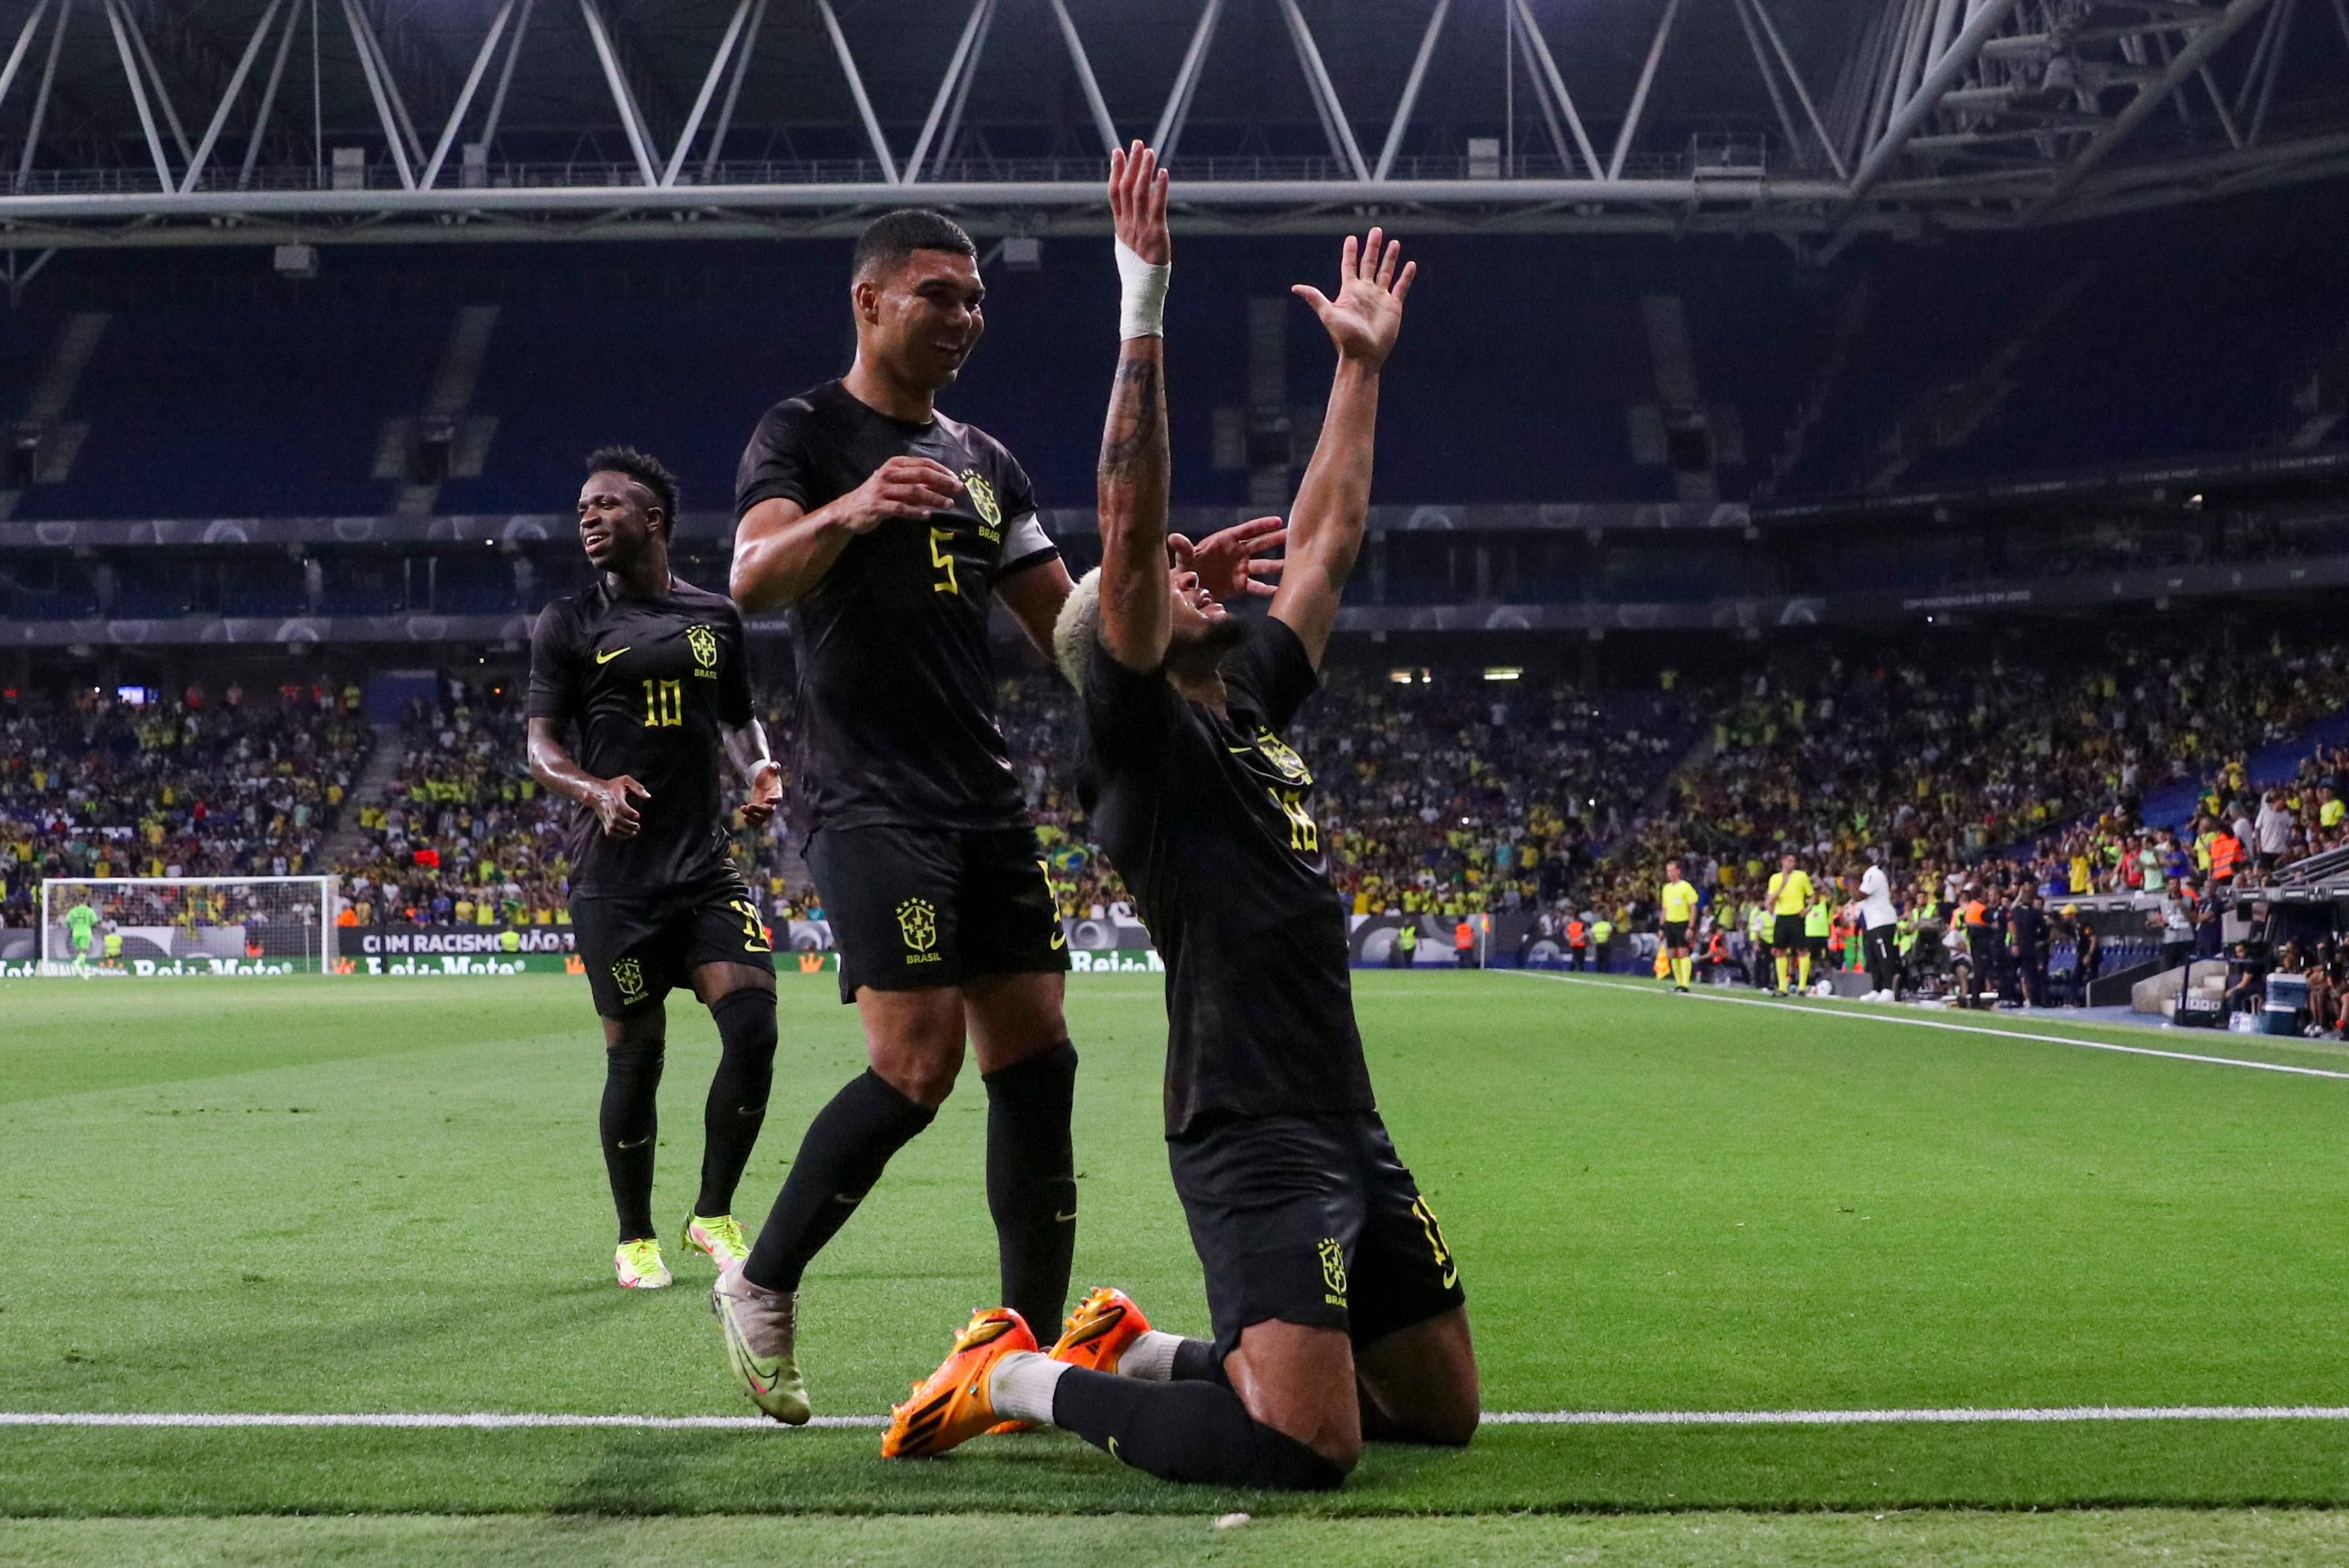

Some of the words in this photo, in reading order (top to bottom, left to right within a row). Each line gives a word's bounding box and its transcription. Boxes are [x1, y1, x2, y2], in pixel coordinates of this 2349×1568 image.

[930, 526, 958, 595] 5
[642, 678, 682, 727] 10
[906, 952, 942, 965] BRASIL
